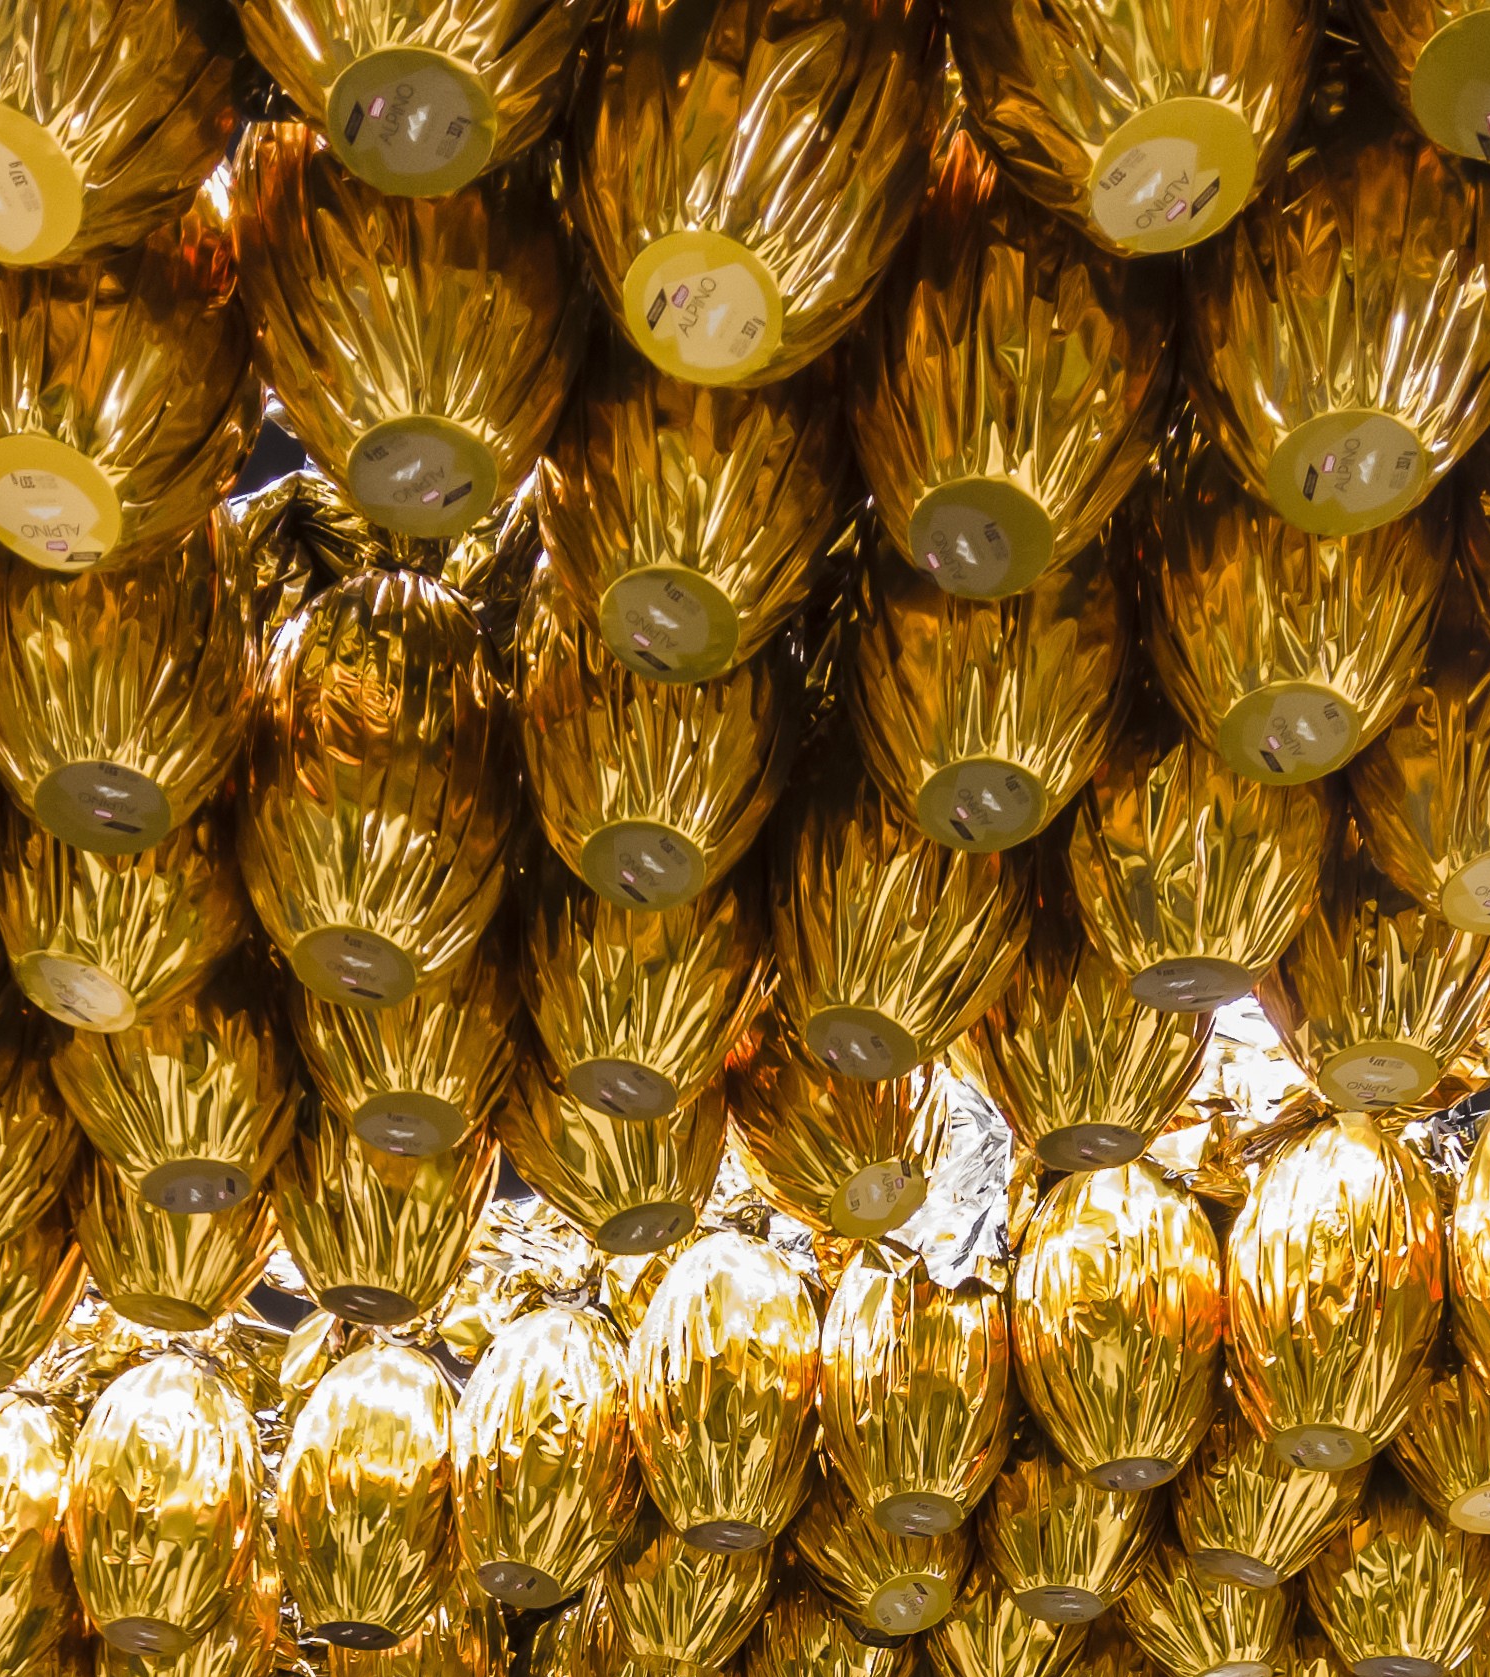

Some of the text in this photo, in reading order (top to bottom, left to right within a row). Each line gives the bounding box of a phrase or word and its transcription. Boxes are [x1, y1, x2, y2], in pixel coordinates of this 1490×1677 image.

[1135, 171, 1188, 229] ALPINO
[678, 276, 718, 339] ALPINO
[21, 522, 80, 538] ALPINO
